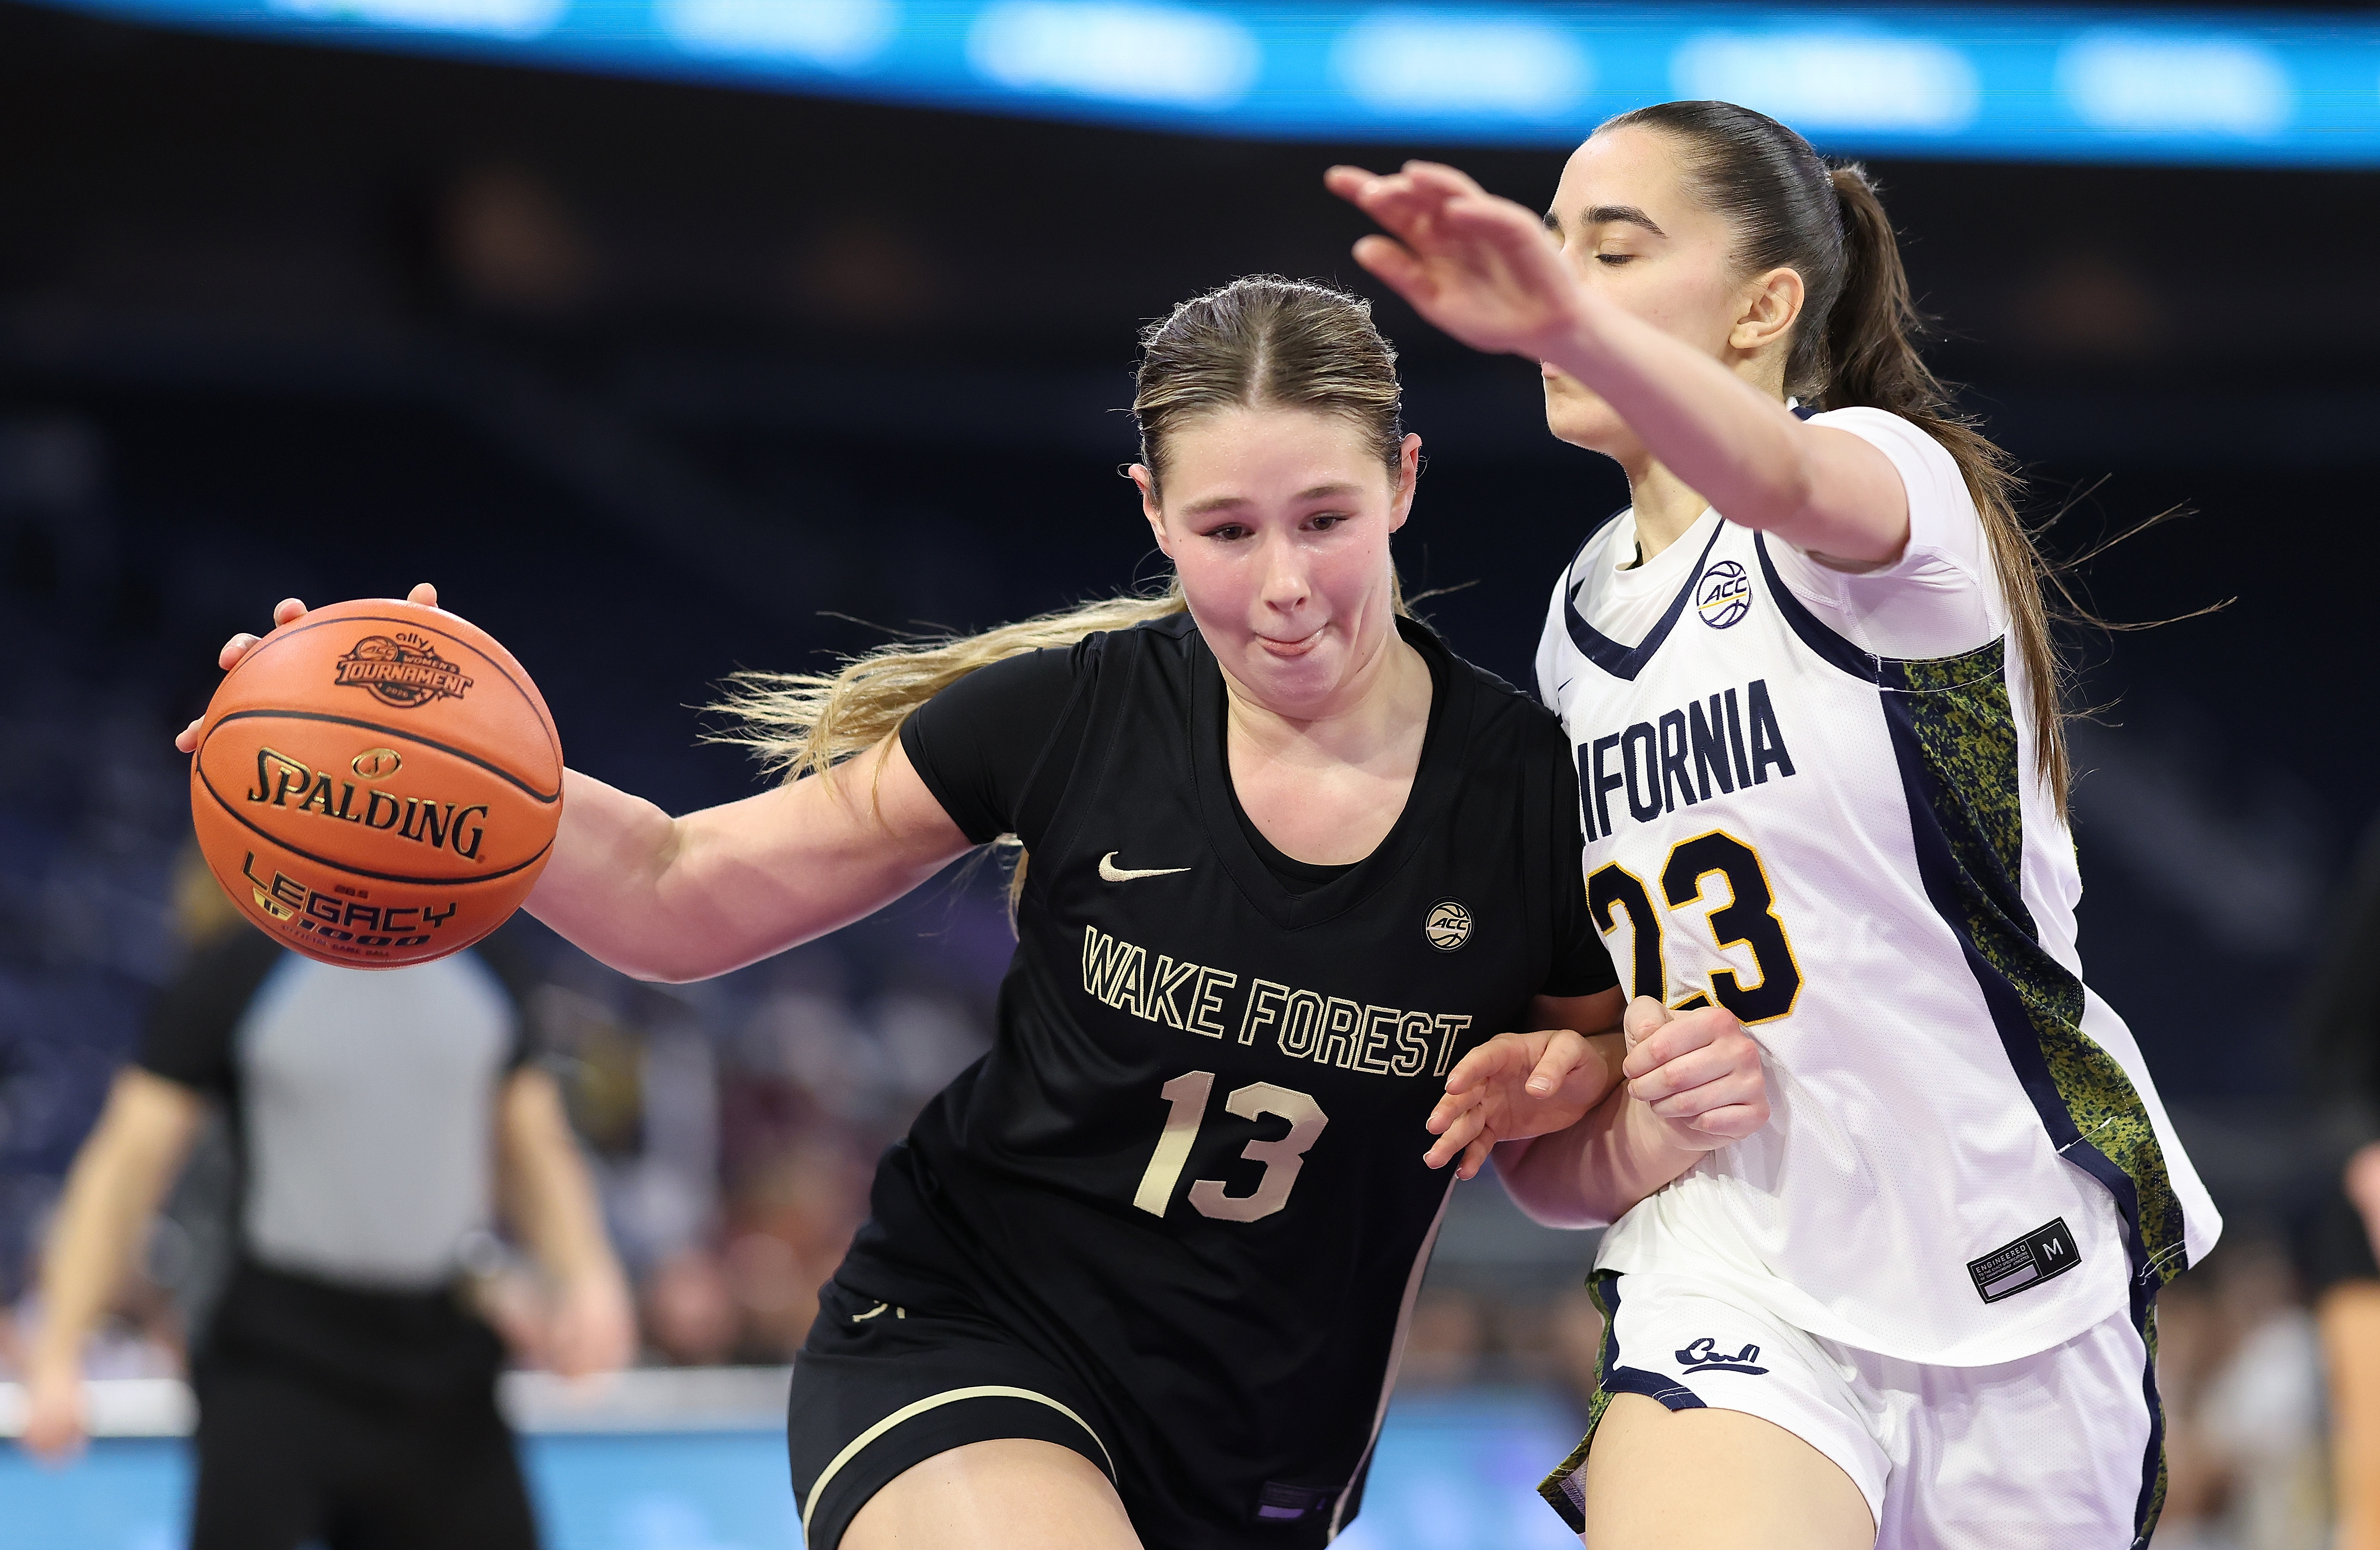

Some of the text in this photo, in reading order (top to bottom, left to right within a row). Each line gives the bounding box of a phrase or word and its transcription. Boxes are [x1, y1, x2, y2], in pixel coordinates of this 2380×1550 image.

[1703, 576, 1747, 604] ACC
[396, 633, 429, 649] ally
[338, 662, 473, 696] TOURNAMENT
[1578, 679, 1795, 846] IFORNIA
[247, 747, 488, 860] SPALDING
[242, 849, 458, 932] LEGACY
[1431, 918, 1470, 930] ACC
[1587, 828, 1804, 1026] 23
[1082, 924, 1472, 1077] WAKE FOREST
[1132, 1070, 1329, 1223] 13
[1976, 1245, 2026, 1273] ENGINEERED
[2042, 1238, 2064, 1261] M
